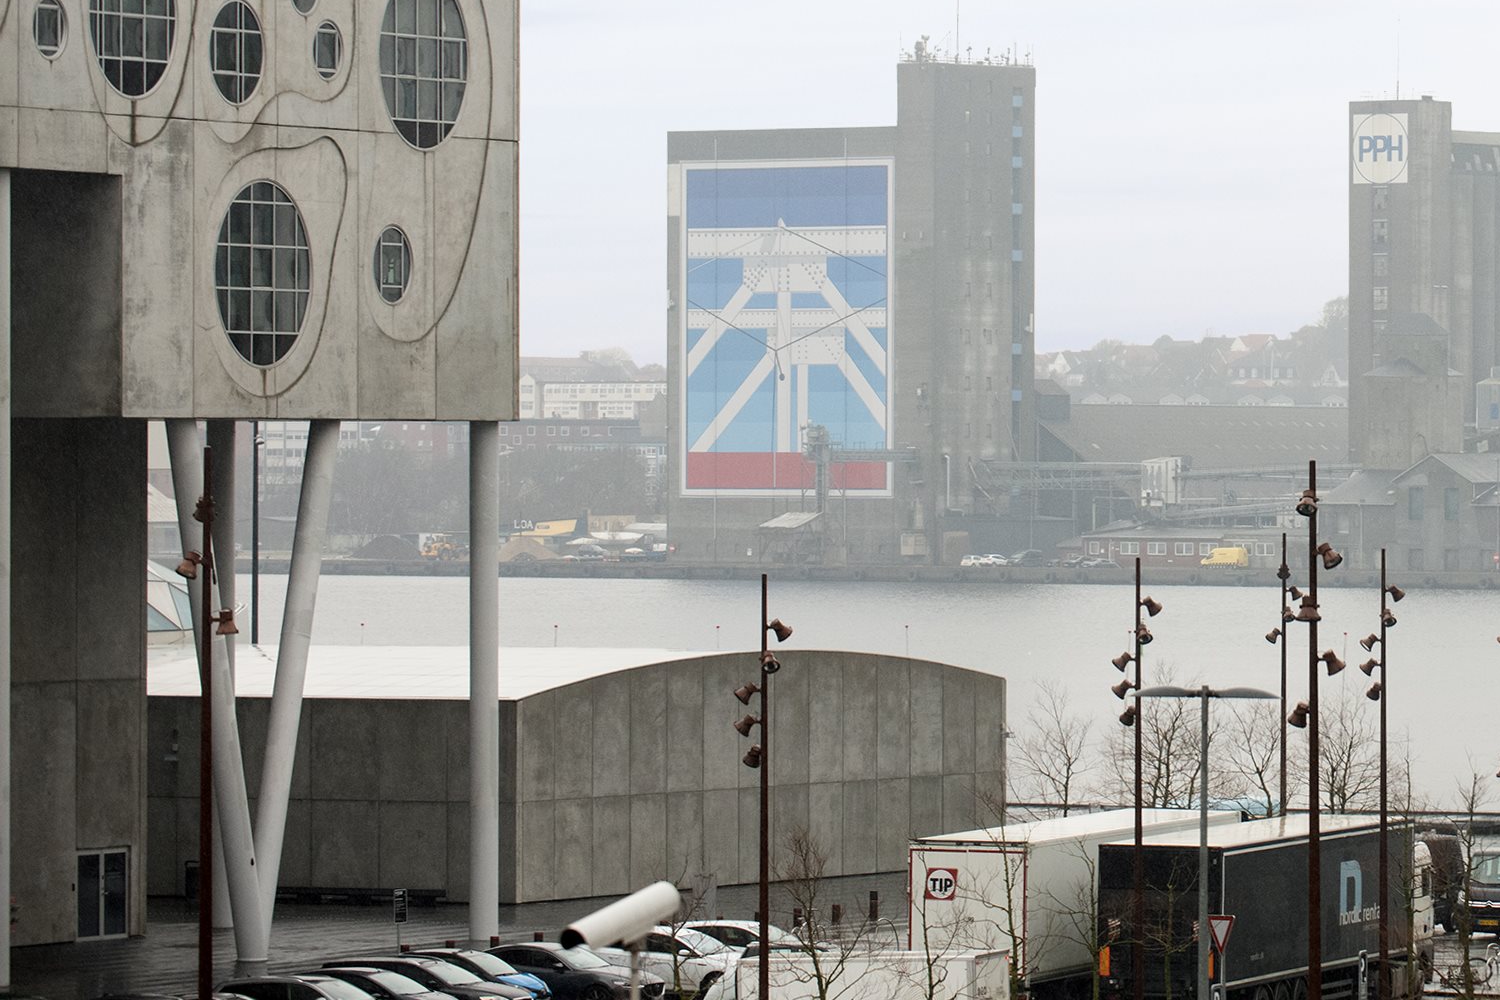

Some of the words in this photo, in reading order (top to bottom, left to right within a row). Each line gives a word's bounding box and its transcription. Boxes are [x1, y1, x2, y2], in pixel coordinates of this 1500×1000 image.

[1359, 135, 1403, 162] PPH
[930, 877, 953, 893] TIP
[1362, 902, 1380, 922] renta
